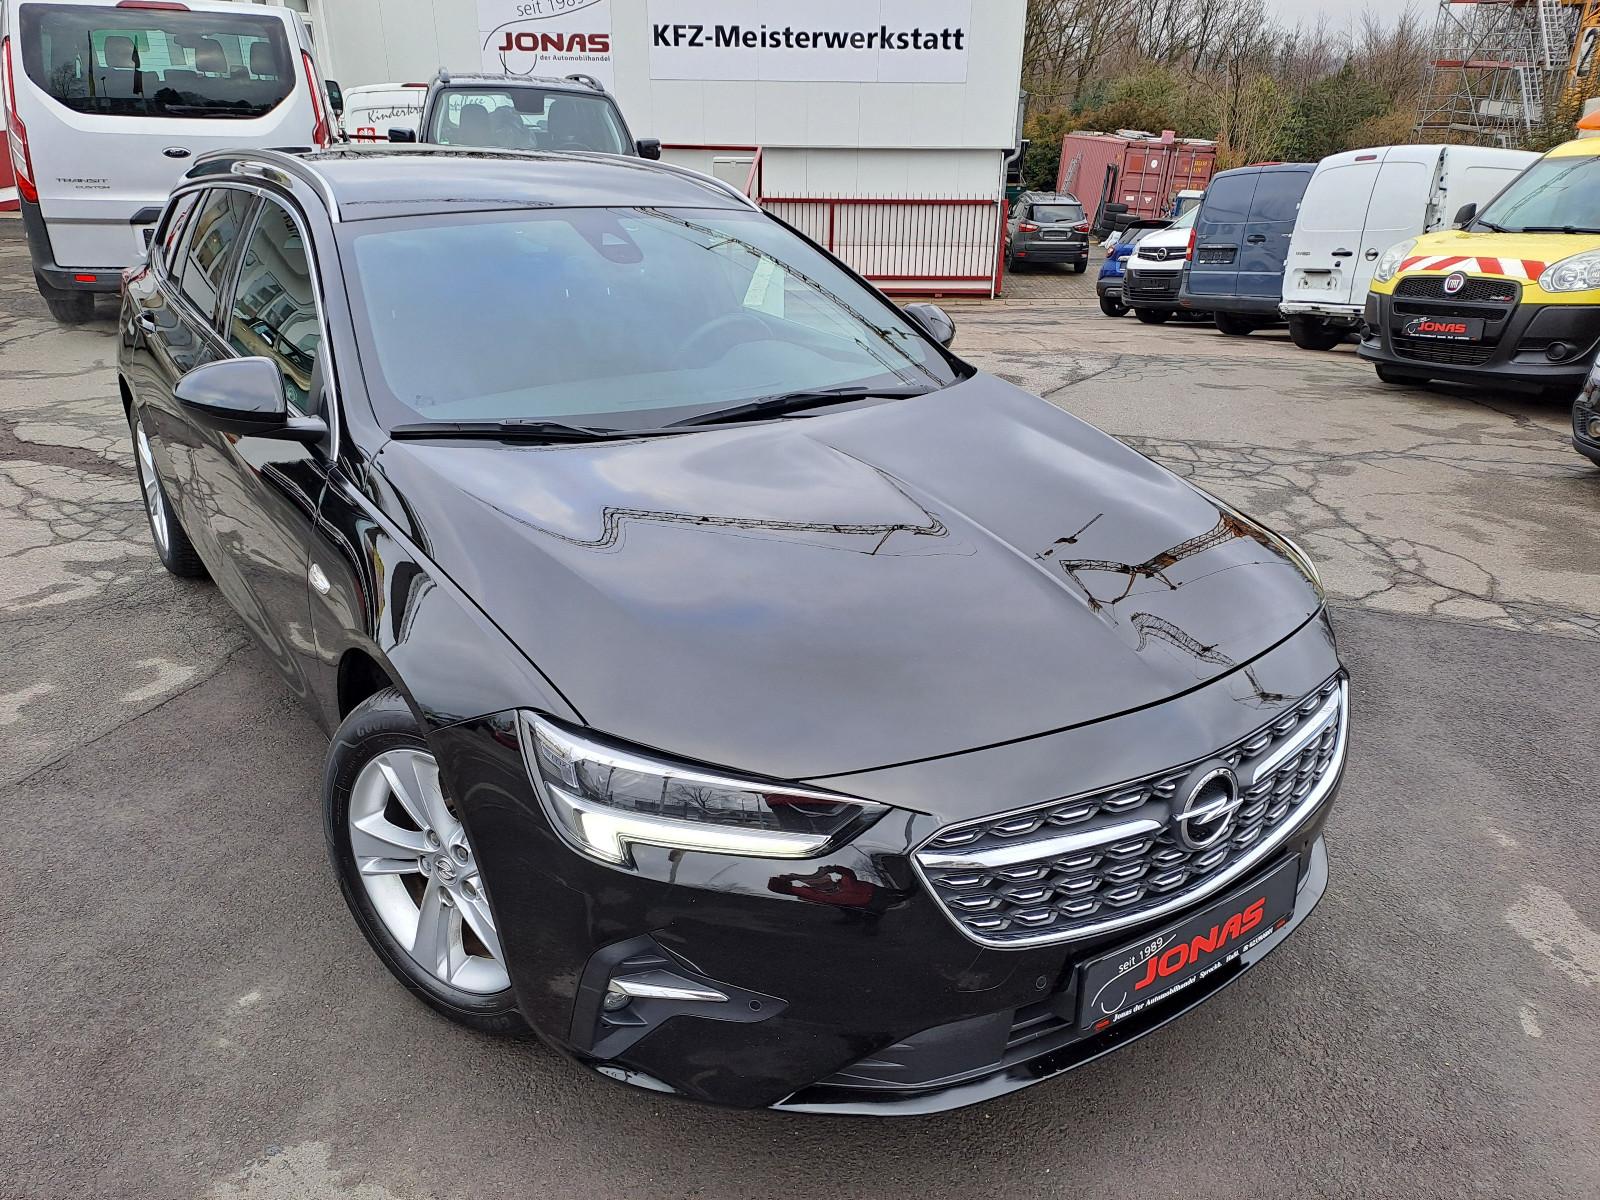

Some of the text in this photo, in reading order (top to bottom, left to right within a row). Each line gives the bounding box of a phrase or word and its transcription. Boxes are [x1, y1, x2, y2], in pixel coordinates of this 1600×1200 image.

[517, 0, 543, 17] seit
[498, 32, 610, 52] JONAS
[652, 24, 965, 50] KFZ-Meisterwerkstatt
[1418, 321, 1467, 333] JONAS
[1134, 897, 1266, 990] JONAS
[1118, 937, 1164, 974] seit 1989
[1112, 1008, 1133, 1022] Jonas
[1133, 1003, 1145, 1013] der
